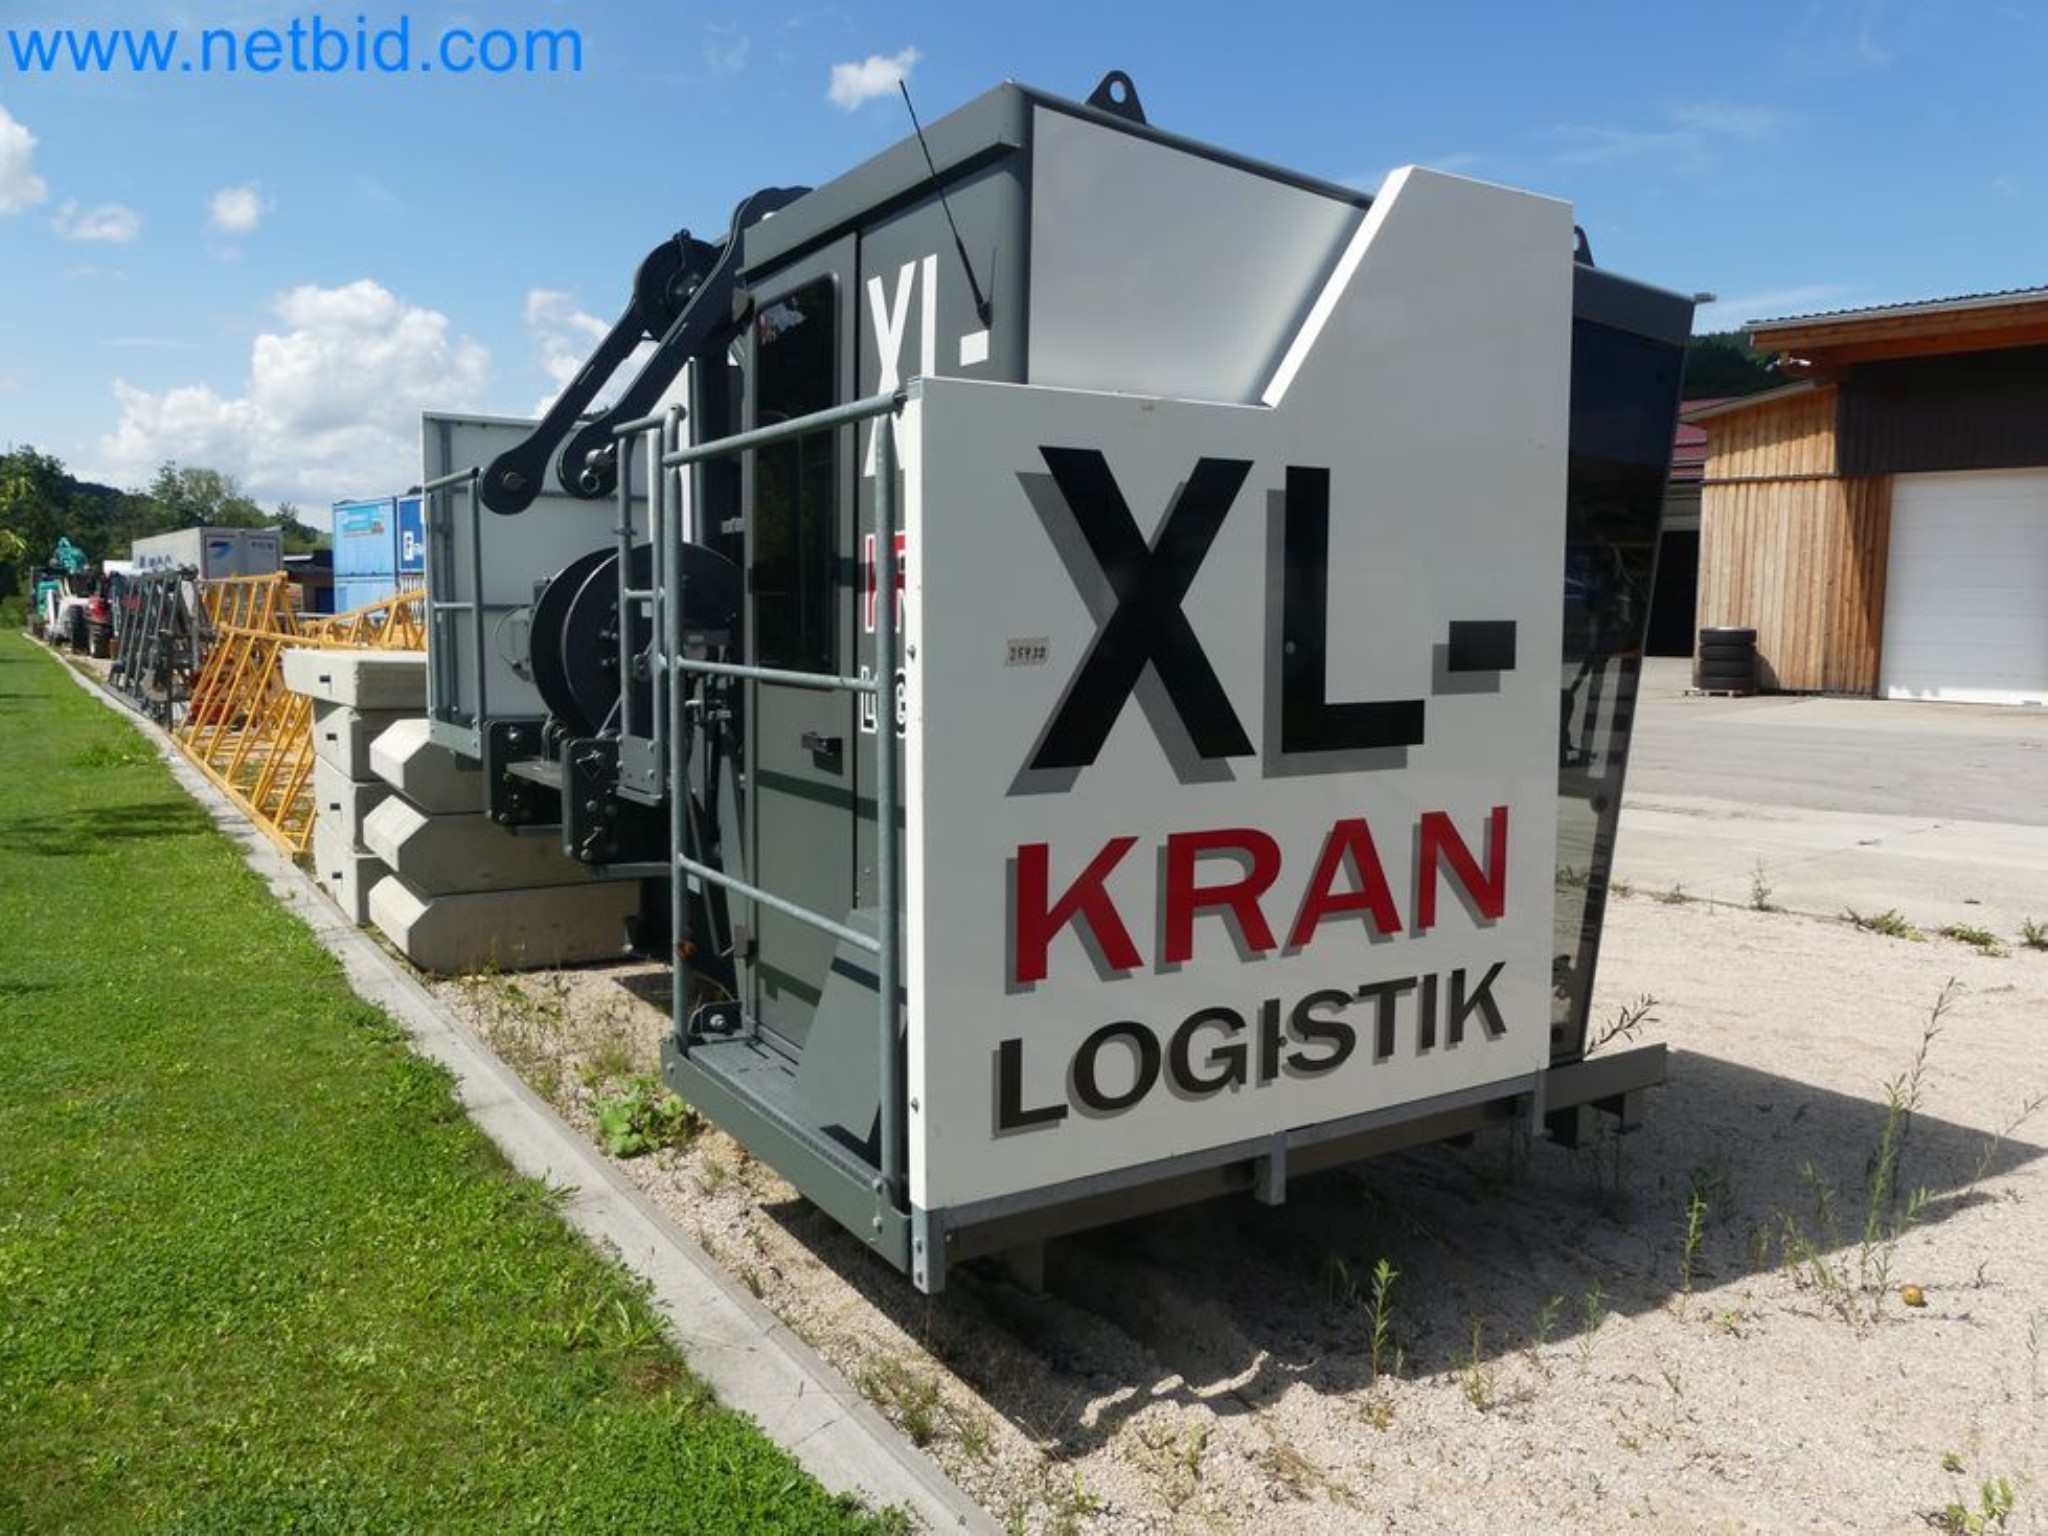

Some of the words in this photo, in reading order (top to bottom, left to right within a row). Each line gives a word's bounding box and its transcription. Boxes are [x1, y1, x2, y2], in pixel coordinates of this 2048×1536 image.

[1021, 445, 1516, 771] XL-
[1014, 805, 1508, 984] KRAN
[996, 960, 1508, 1130] LOGISTIK
